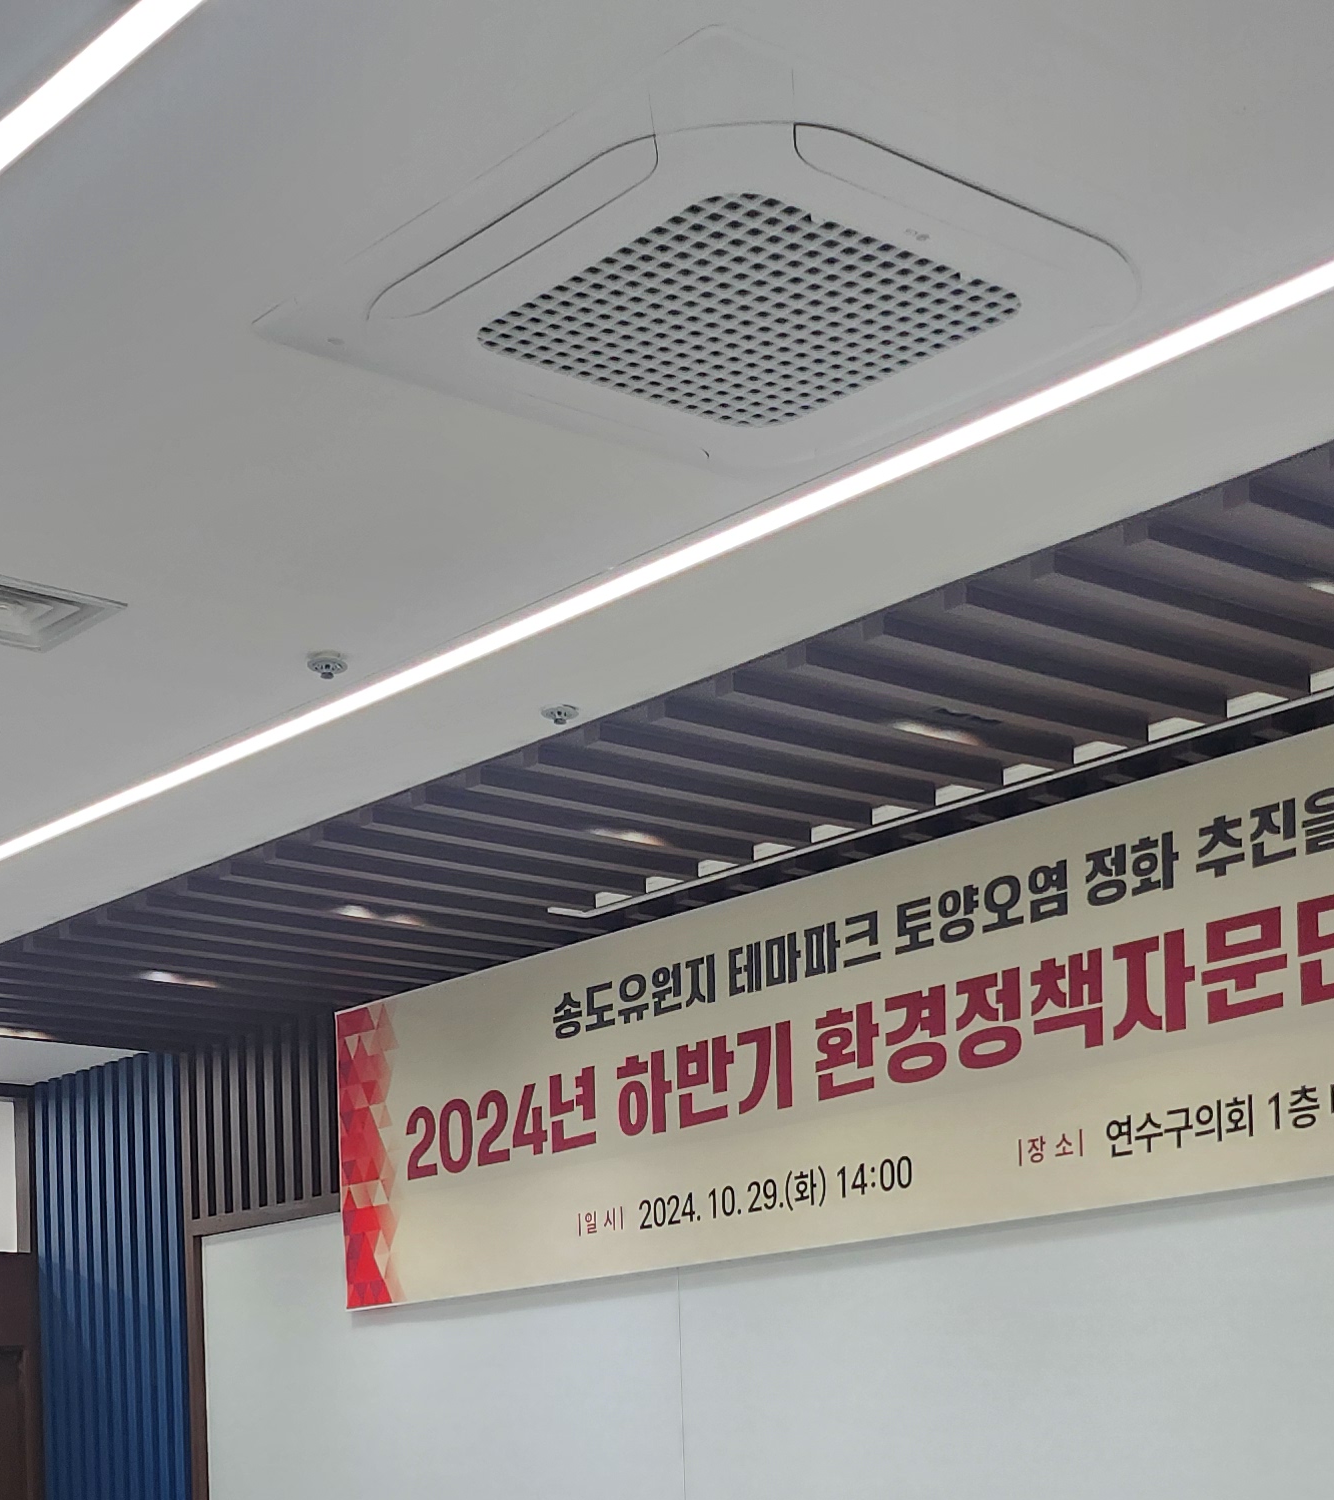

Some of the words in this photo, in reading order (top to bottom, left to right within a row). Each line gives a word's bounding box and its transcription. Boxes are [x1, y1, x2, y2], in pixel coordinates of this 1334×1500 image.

[552, 952, 716, 1040] 송도유원지
[727, 909, 882, 997] 테마파크
[894, 858, 1069, 956] 토양오염
[1085, 830, 1180, 907] 정화
[405, 1065, 597, 1181] 2024년
[616, 1019, 793, 1137] 하반기
[1106, 1093, 1254, 1158] 연수구의회
[1268, 1084, 1320, 1130] 1층
[836, 1155, 913, 1199] 14:00
